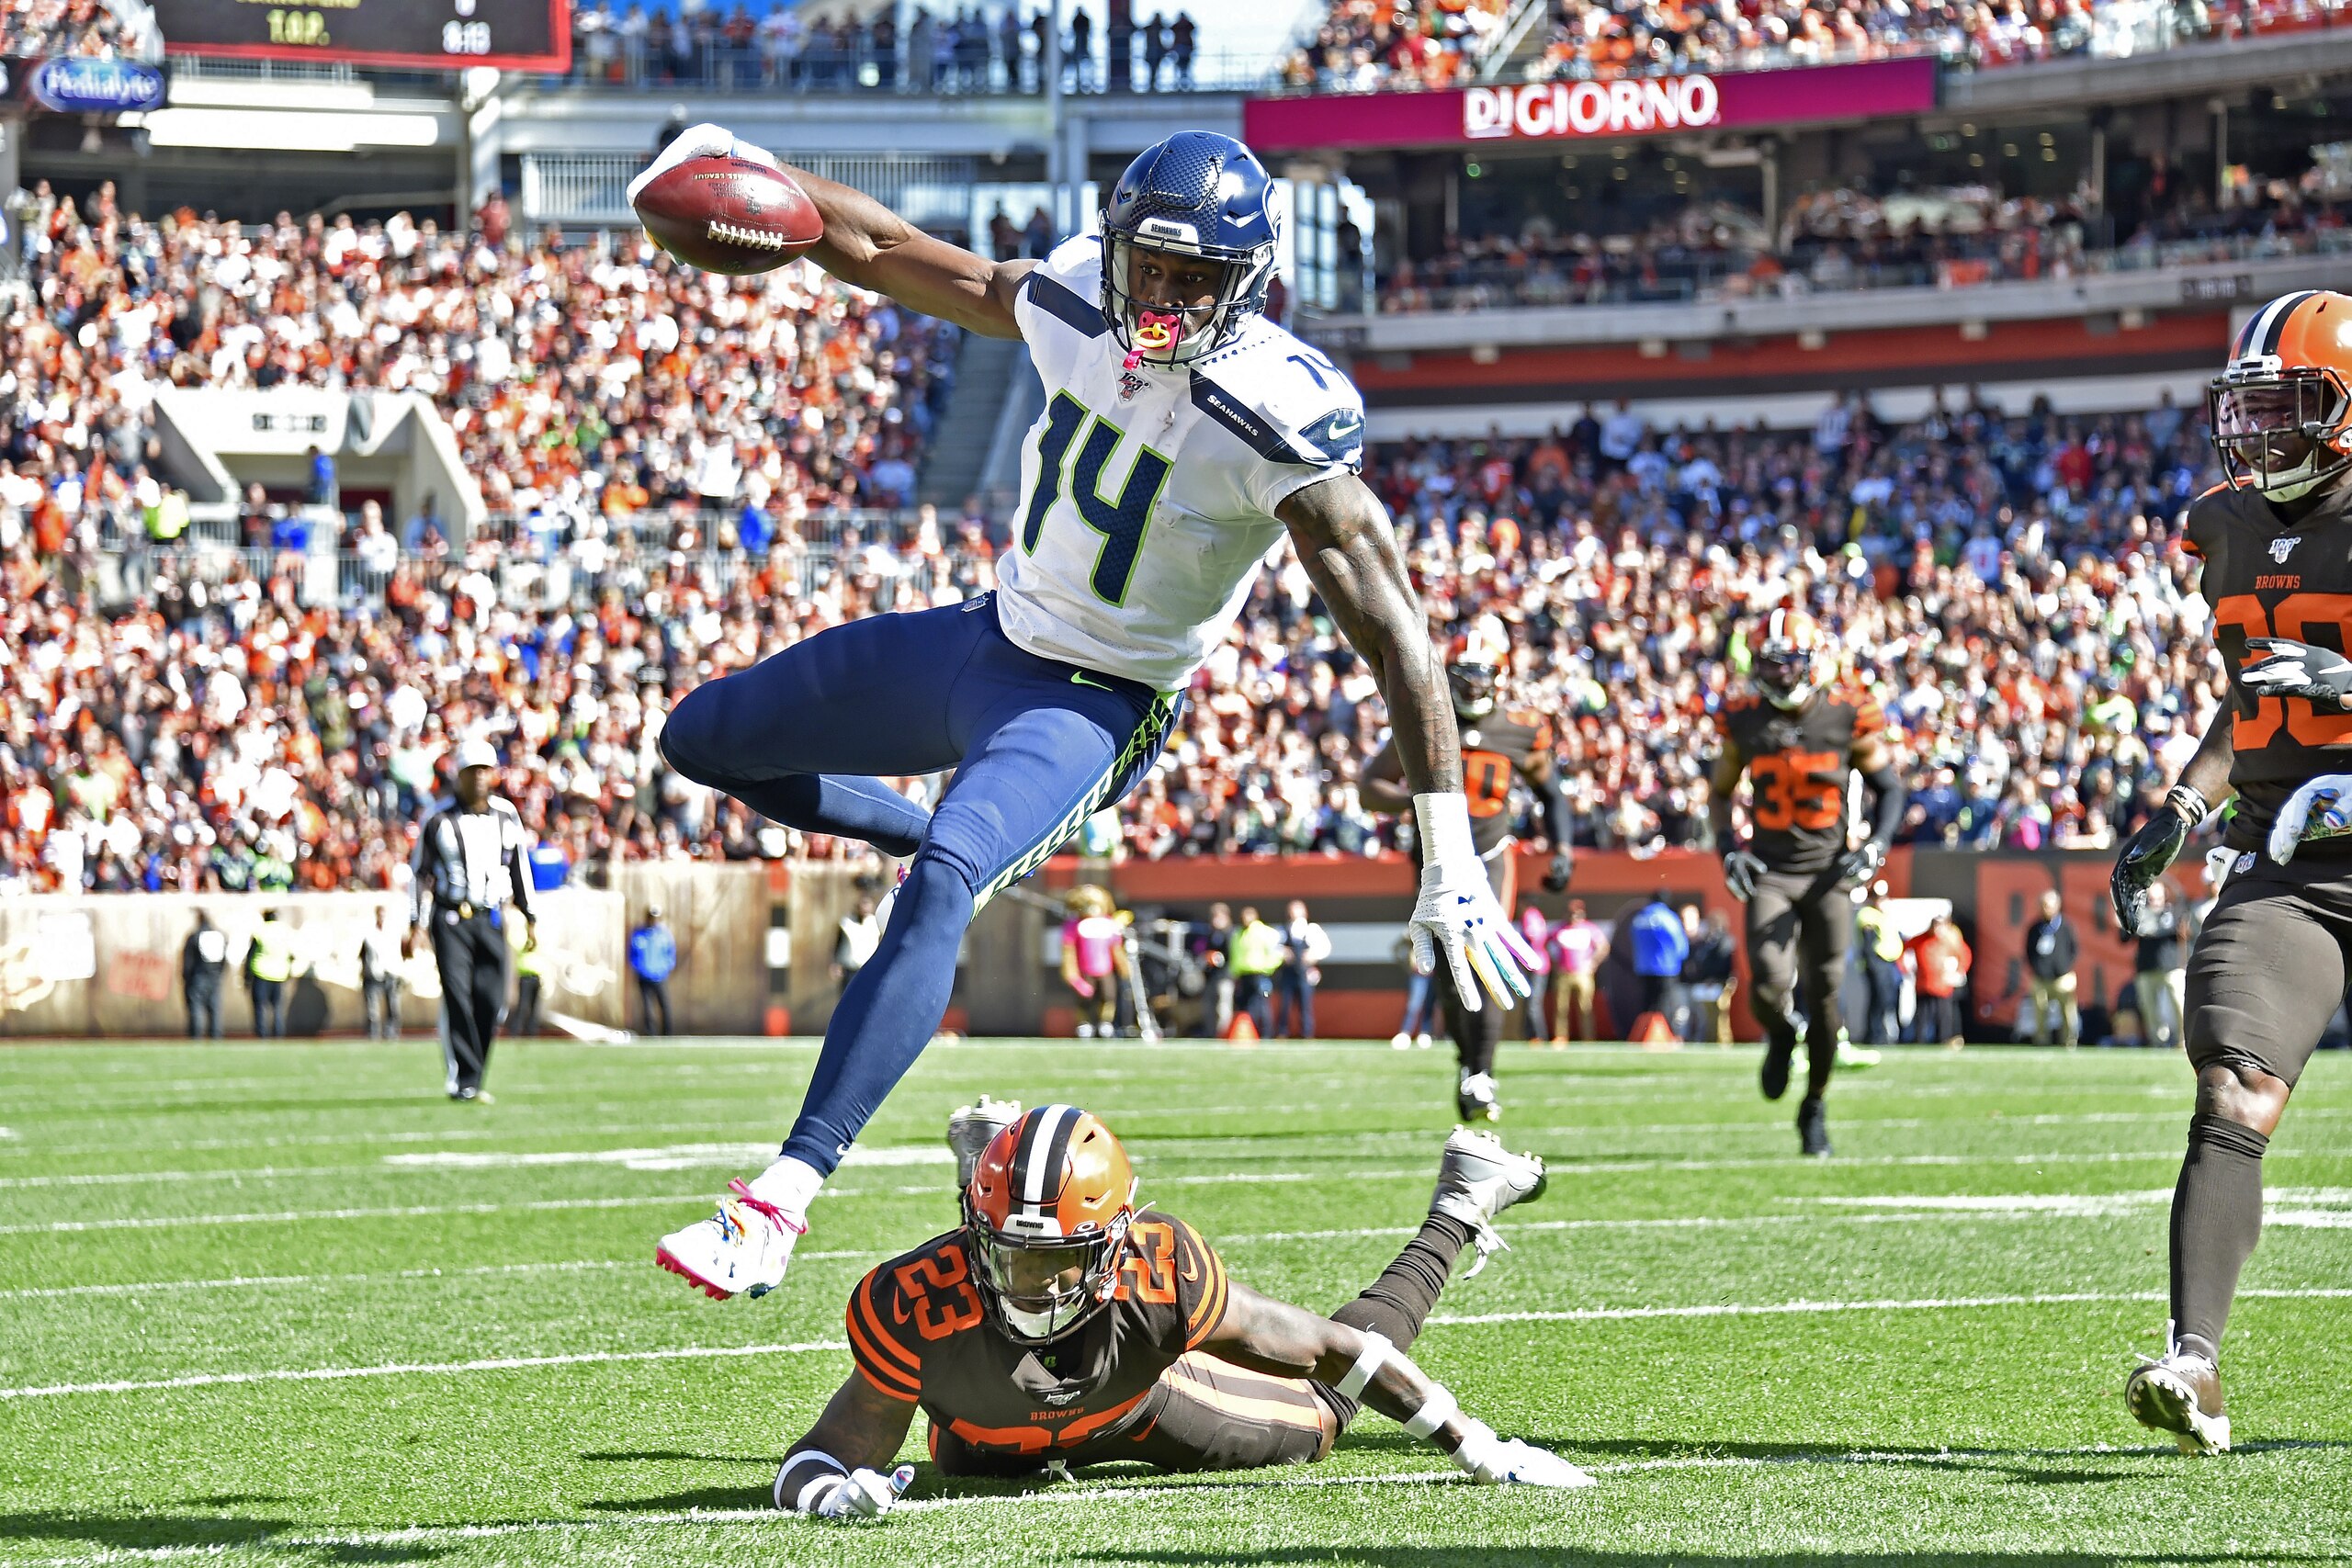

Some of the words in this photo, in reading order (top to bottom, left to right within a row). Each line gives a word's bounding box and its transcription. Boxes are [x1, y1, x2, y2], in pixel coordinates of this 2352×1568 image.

[1150, 223, 1183, 237] SEAHAWKS
[1206, 394, 1260, 438] SEAHAWKS
[1022, 388, 1174, 609] 14
[2255, 575, 2301, 589] BROWNS
[1461, 749, 1513, 818] 0
[1750, 750, 1841, 829] 35
[894, 1244, 985, 1341] 23
[1112, 1221, 1177, 1304] 23
[1030, 1406, 1085, 1421] BROWNS
